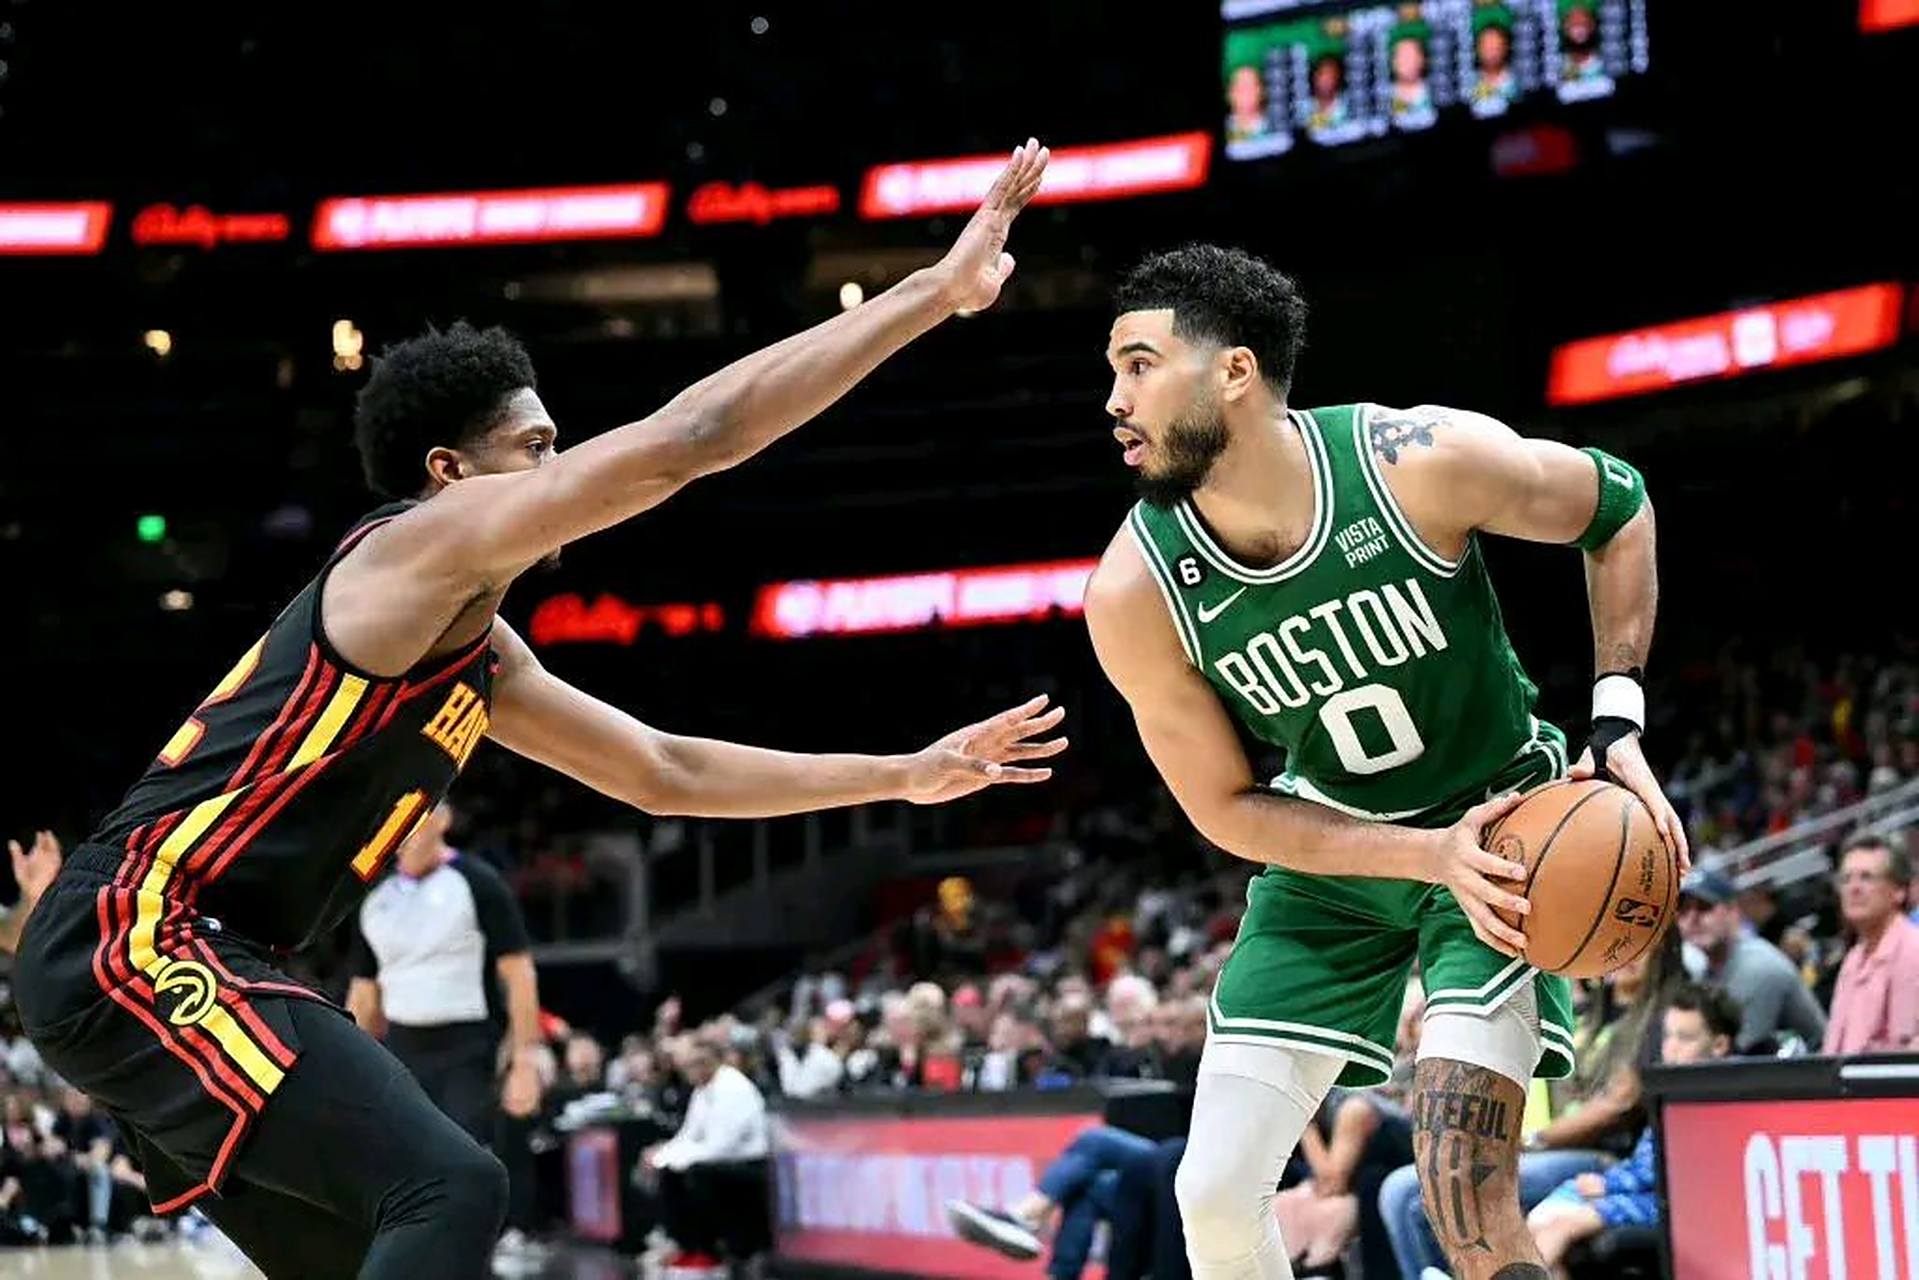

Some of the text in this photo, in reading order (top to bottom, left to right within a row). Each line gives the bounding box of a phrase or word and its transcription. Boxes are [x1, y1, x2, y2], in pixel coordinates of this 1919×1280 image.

[1335, 517, 1383, 552] VISTA
[1345, 534, 1389, 568] PRINT
[1179, 557, 1202, 585] 6
[1214, 578, 1448, 715] BOSTON
[1319, 683, 1425, 774] 0
[1744, 1132, 1848, 1280] GET
